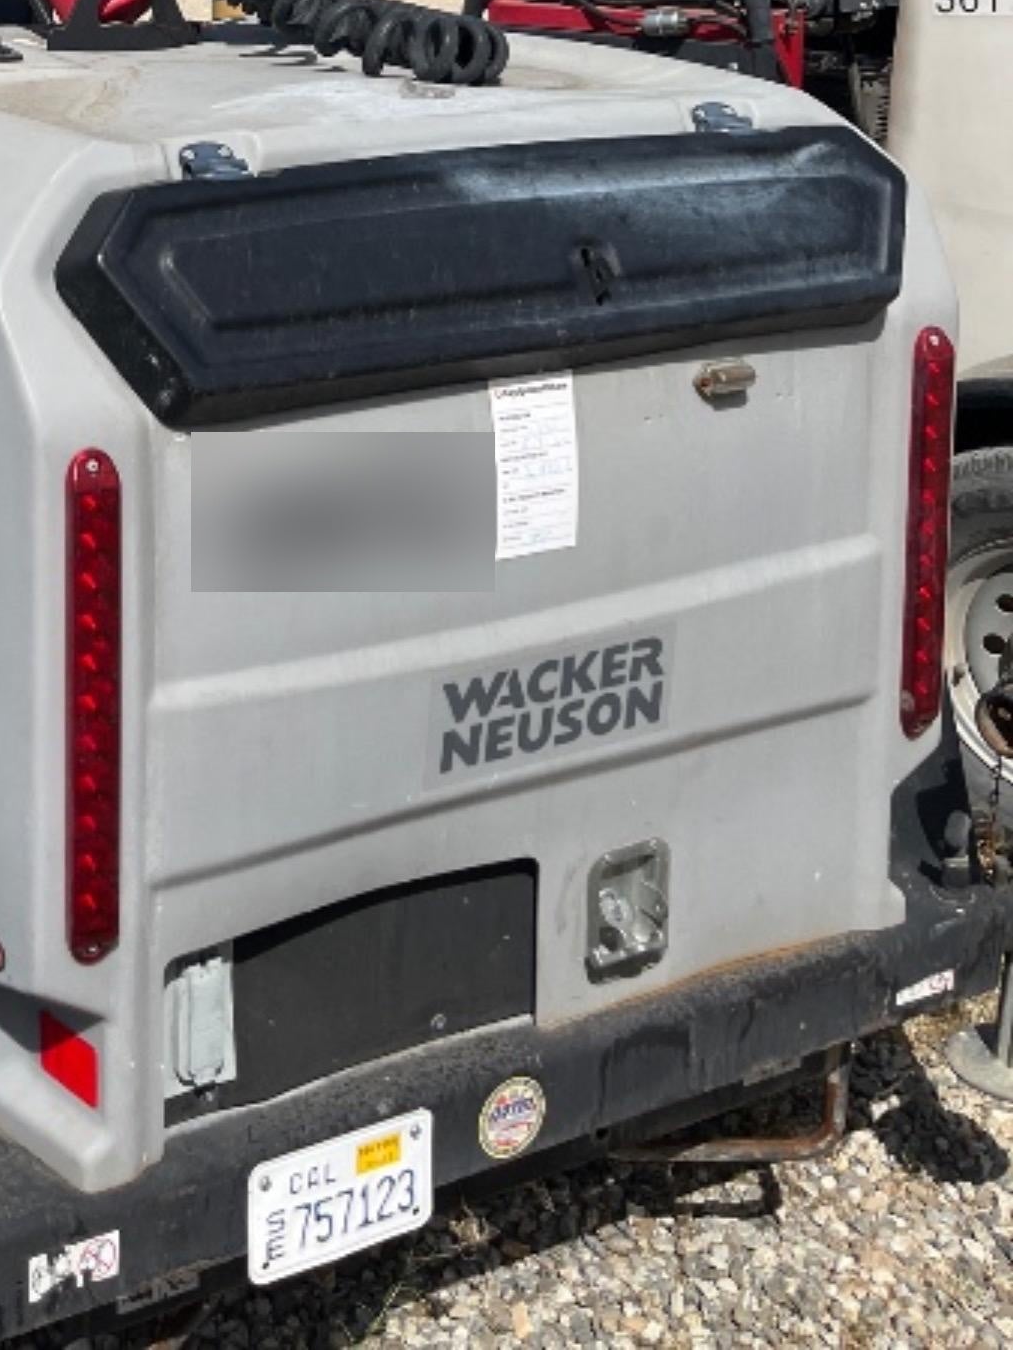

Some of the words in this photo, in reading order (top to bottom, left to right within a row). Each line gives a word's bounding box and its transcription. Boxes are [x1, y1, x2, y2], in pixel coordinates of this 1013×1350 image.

[442, 636, 664, 724] WACKER
[440, 680, 663, 775] NEUSON
[290, 1162, 336, 1195] CAL
[294, 1168, 415, 1251] 757123
